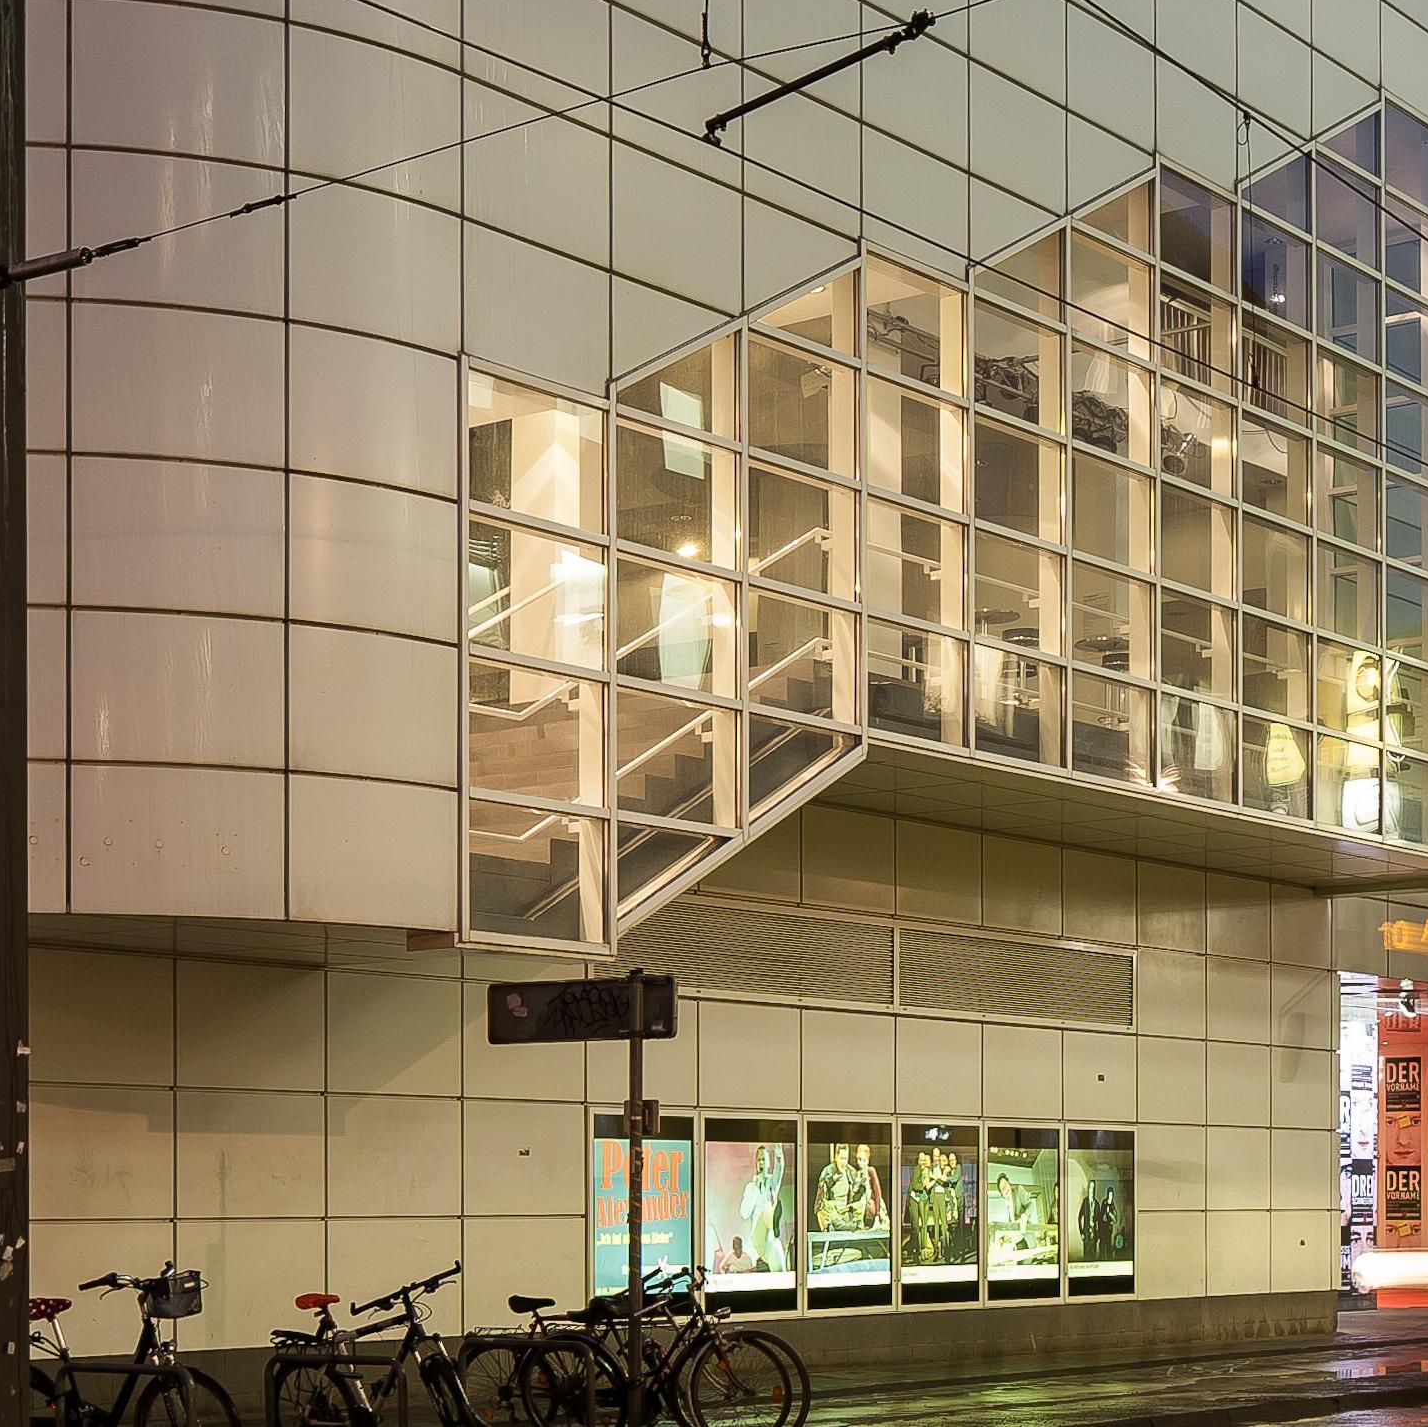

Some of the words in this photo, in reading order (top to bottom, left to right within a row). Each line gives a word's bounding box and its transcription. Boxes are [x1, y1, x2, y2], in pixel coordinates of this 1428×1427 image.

[1386, 1062, 1420, 1083] DER
[1386, 1171, 1420, 1191] DER
[596, 1191, 688, 1229] Alender
